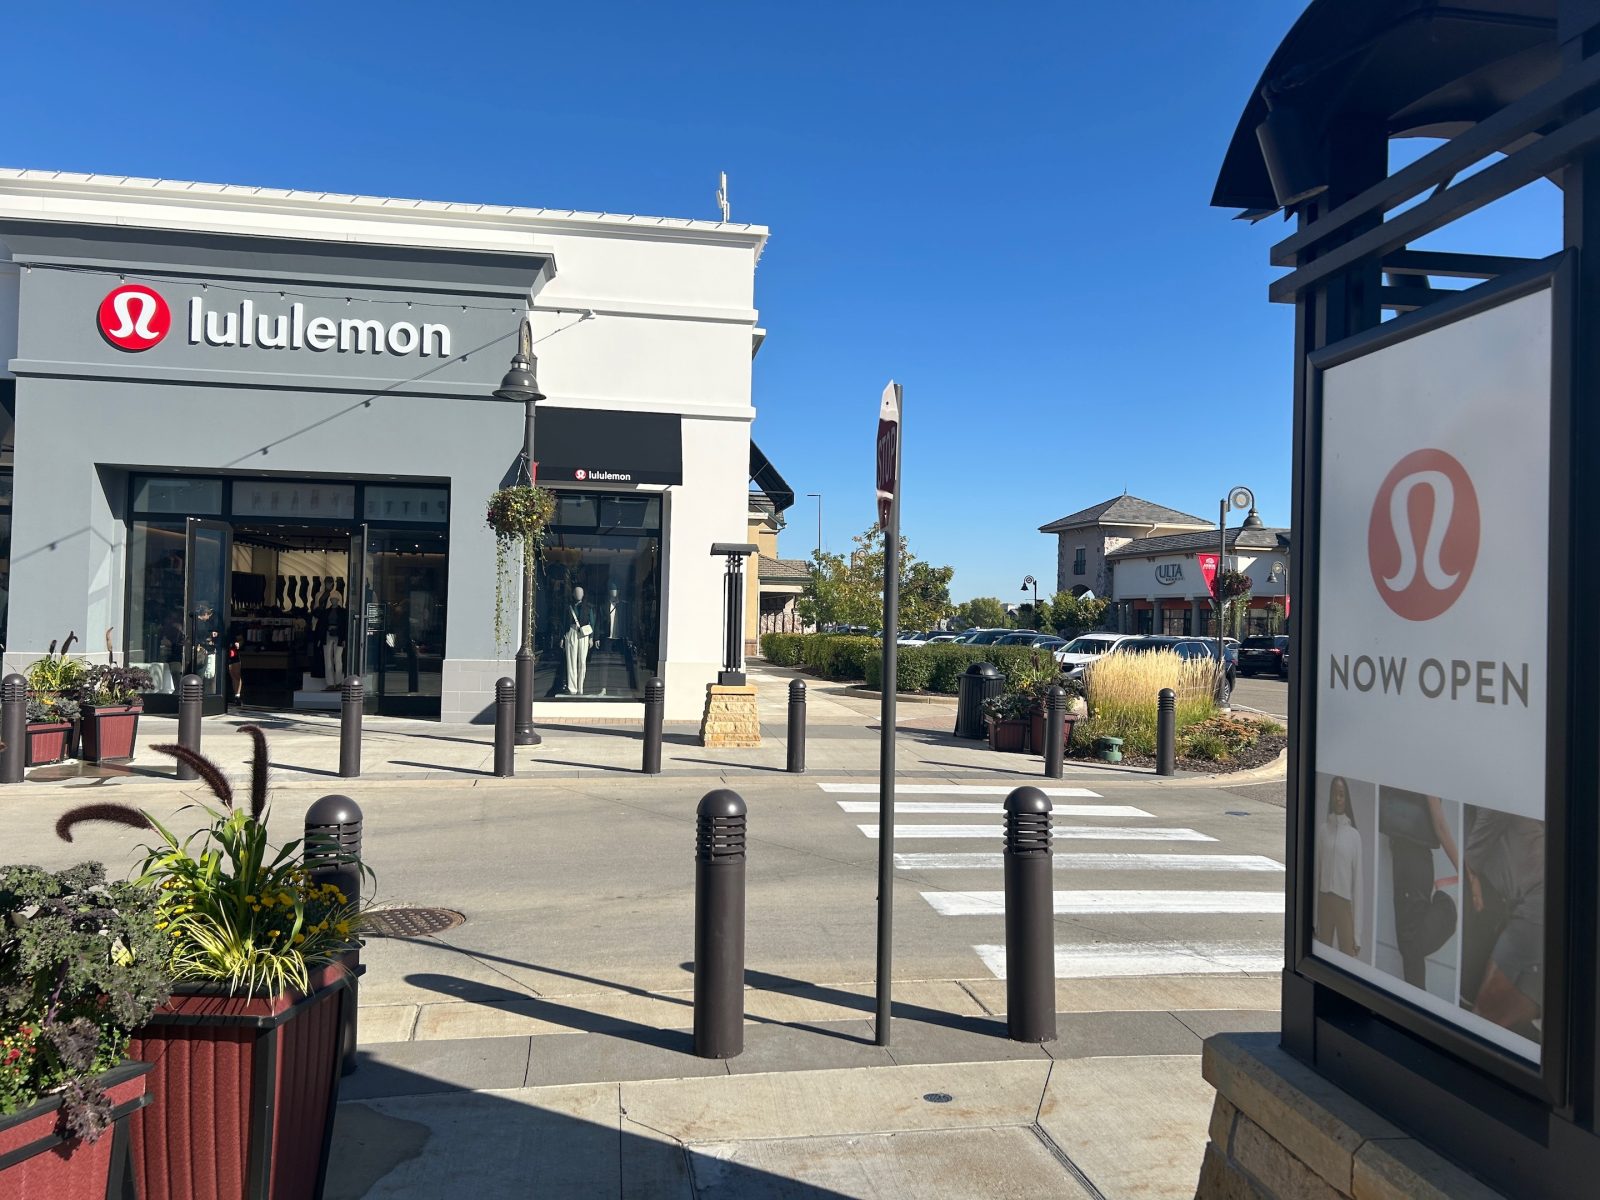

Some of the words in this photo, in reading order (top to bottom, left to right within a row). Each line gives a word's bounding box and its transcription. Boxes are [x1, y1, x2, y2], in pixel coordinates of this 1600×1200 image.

[190, 296, 451, 356] lululemon
[588, 470, 631, 481] lululemon
[877, 426, 897, 486] STOP
[1159, 564, 1183, 579] ULTA
[1330, 653, 1407, 696] NOW
[1418, 657, 1529, 708] OPEN
